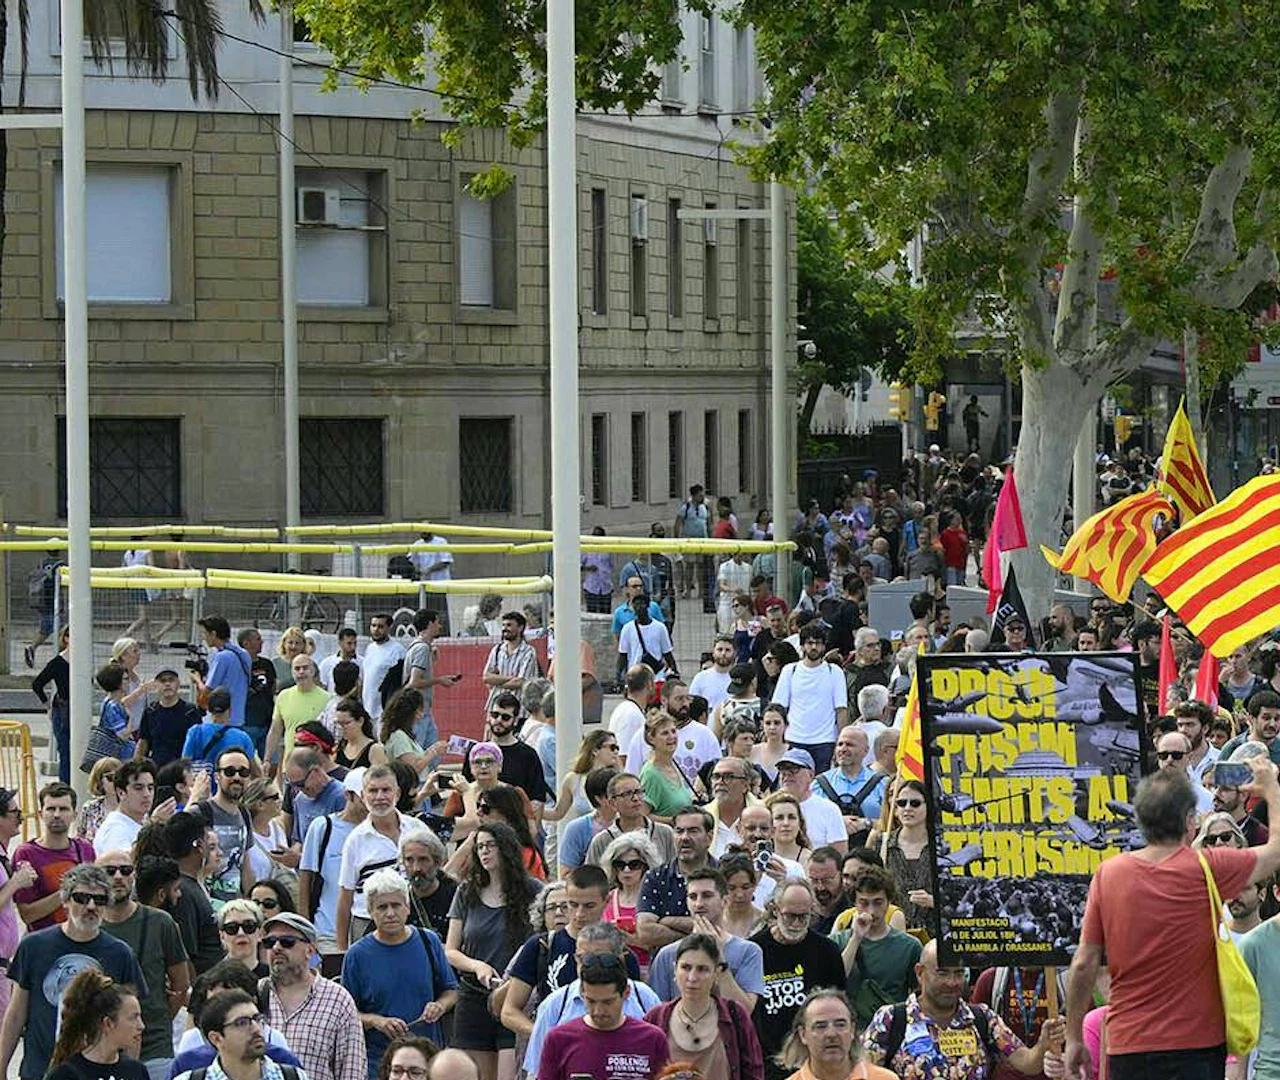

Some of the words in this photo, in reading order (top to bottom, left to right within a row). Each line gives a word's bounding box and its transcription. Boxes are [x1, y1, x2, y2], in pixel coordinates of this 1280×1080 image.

[971, 930, 999, 940] JULIOL
[952, 942, 964, 952] LA
[965, 942, 999, 952] RAMBLA
[1005, 942, 1053, 952] DRASSANES
[763, 980, 805, 999] STOP
